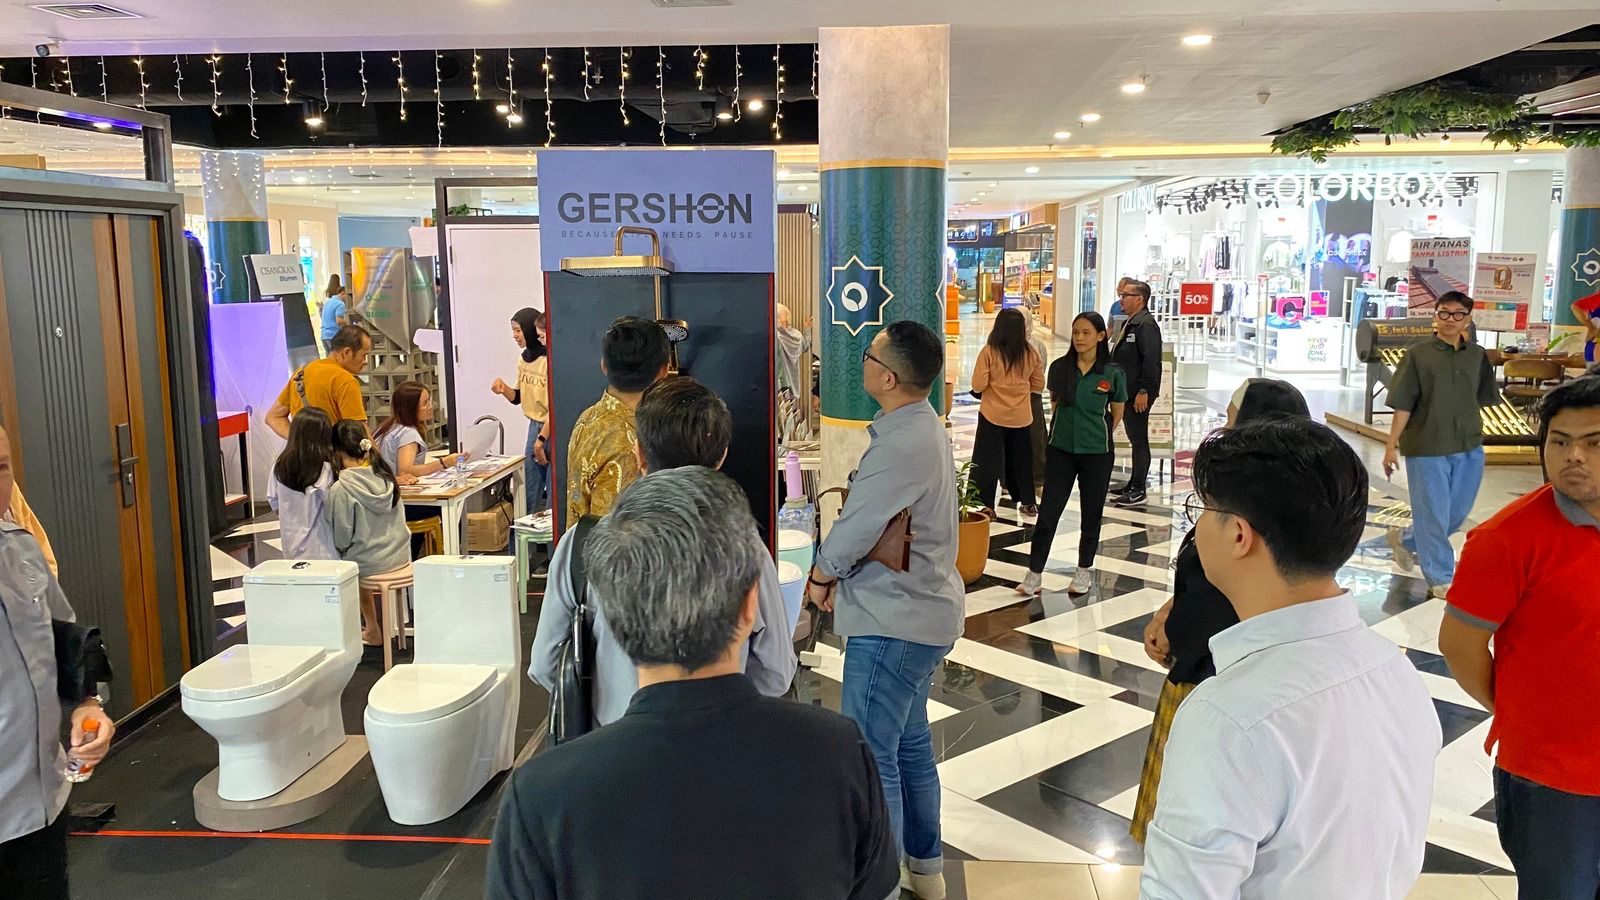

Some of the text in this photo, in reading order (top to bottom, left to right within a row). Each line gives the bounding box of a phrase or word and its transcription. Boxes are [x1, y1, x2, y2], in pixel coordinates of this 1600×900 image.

[1249, 171, 1453, 202] COLORBOX
[557, 192, 752, 224] GERSHON
[561, 230, 616, 238] BECAUSE
[662, 231, 702, 239] NEEDS
[714, 231, 753, 239] PAUSE
[1411, 239, 1470, 249] AIR PANAS
[1184, 294, 1209, 305] 50%
